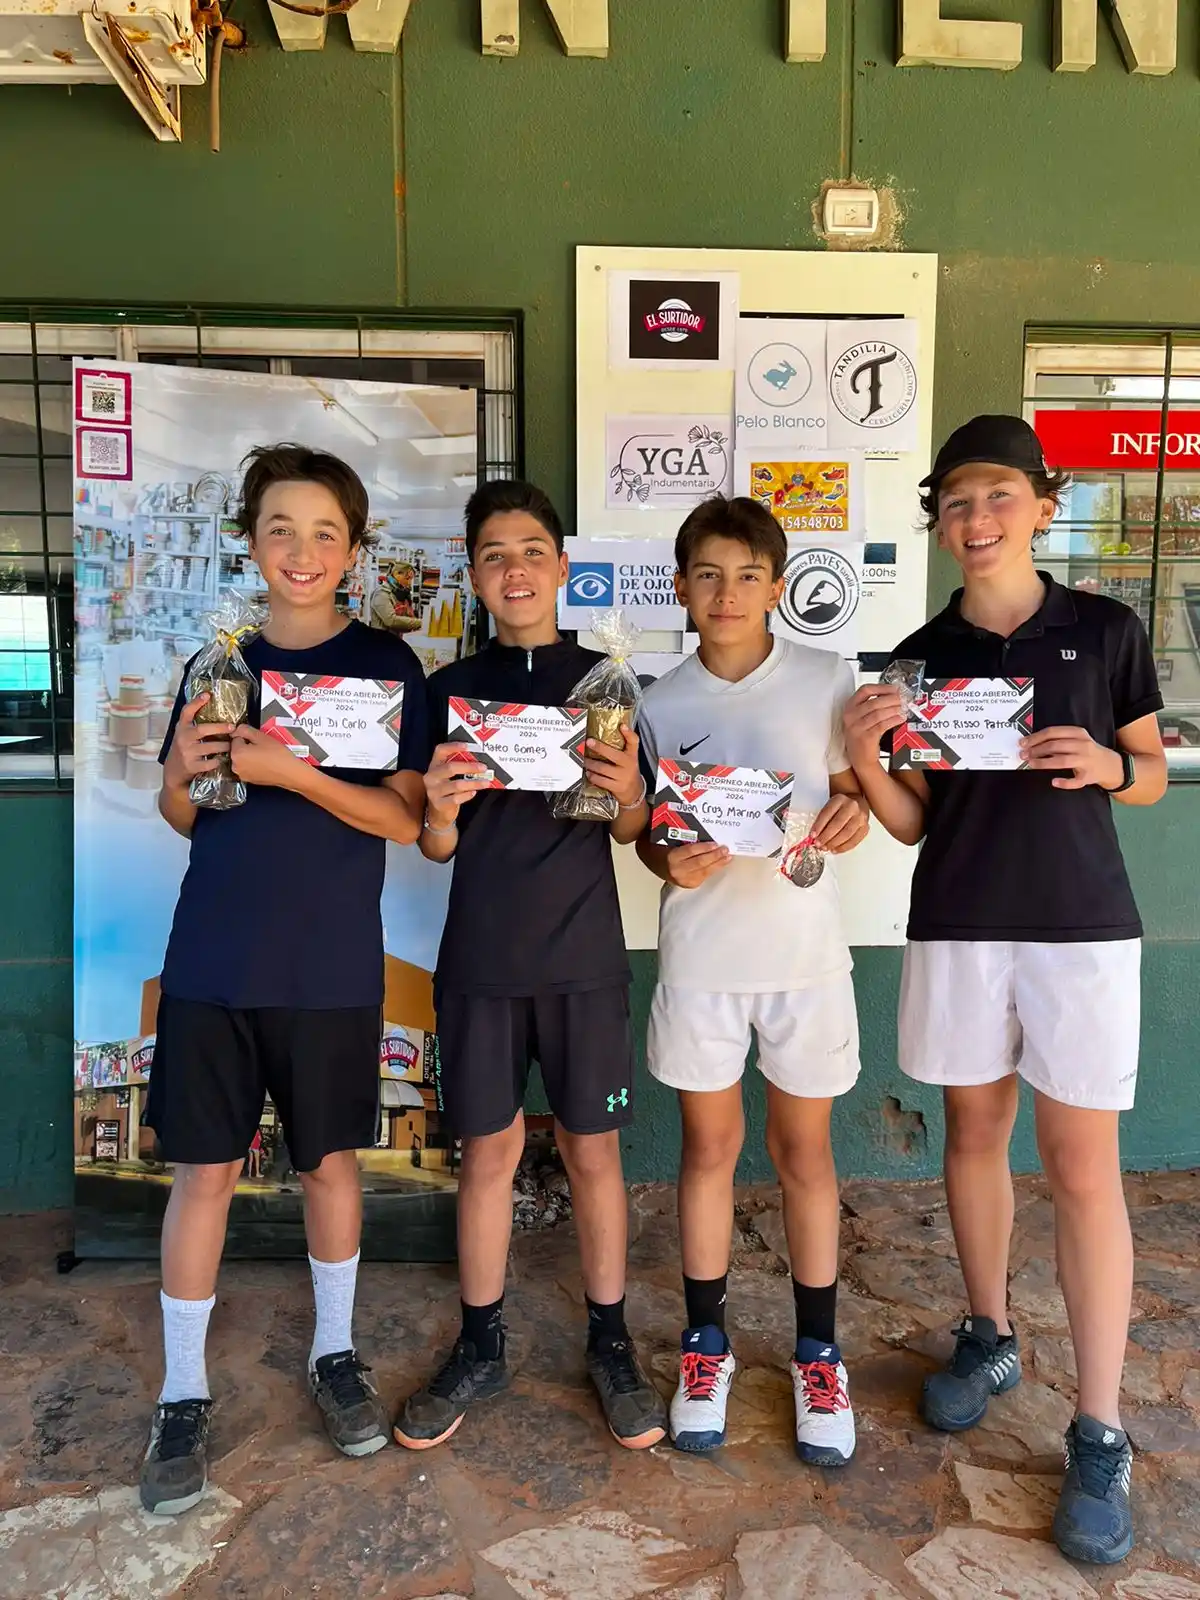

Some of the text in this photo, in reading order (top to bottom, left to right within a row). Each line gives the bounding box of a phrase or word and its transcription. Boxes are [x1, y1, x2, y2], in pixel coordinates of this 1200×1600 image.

[646, 311, 701, 329] EL SURTIDOR
[834, 344, 887, 379] TANDILIA
[736, 414, 826, 428] Pelo Blanco
[1110, 432, 1200, 455] INFOR
[637, 448, 709, 476] YGA
[650, 478, 715, 488] Indumentaria
[780, 516, 844, 529] 154548703
[808, 553, 842, 571] PAYES
[620, 578, 675, 590] DE OJO
[619, 592, 680, 605] TANDIL
[302, 687, 317, 695] 4to
[319, 688, 352, 697] TORNEO
[353, 690, 388, 700] ABIERTO
[948, 690, 981, 698] TORNEO
[292, 716, 322, 733] Angel
[342, 717, 367, 730] Carlo
[502, 715, 535, 724] TORNEO
[536, 718, 571, 727] ABIERTO
[325, 731, 352, 739] PUESTO
[482, 741, 547, 759] Mateo Gomez
[710, 776, 743, 786] TORNEO
[744, 780, 778, 790] ABIERTO
[676, 801, 761, 819] Juan Cruz Marino
[715, 818, 741, 828] PUESTO
